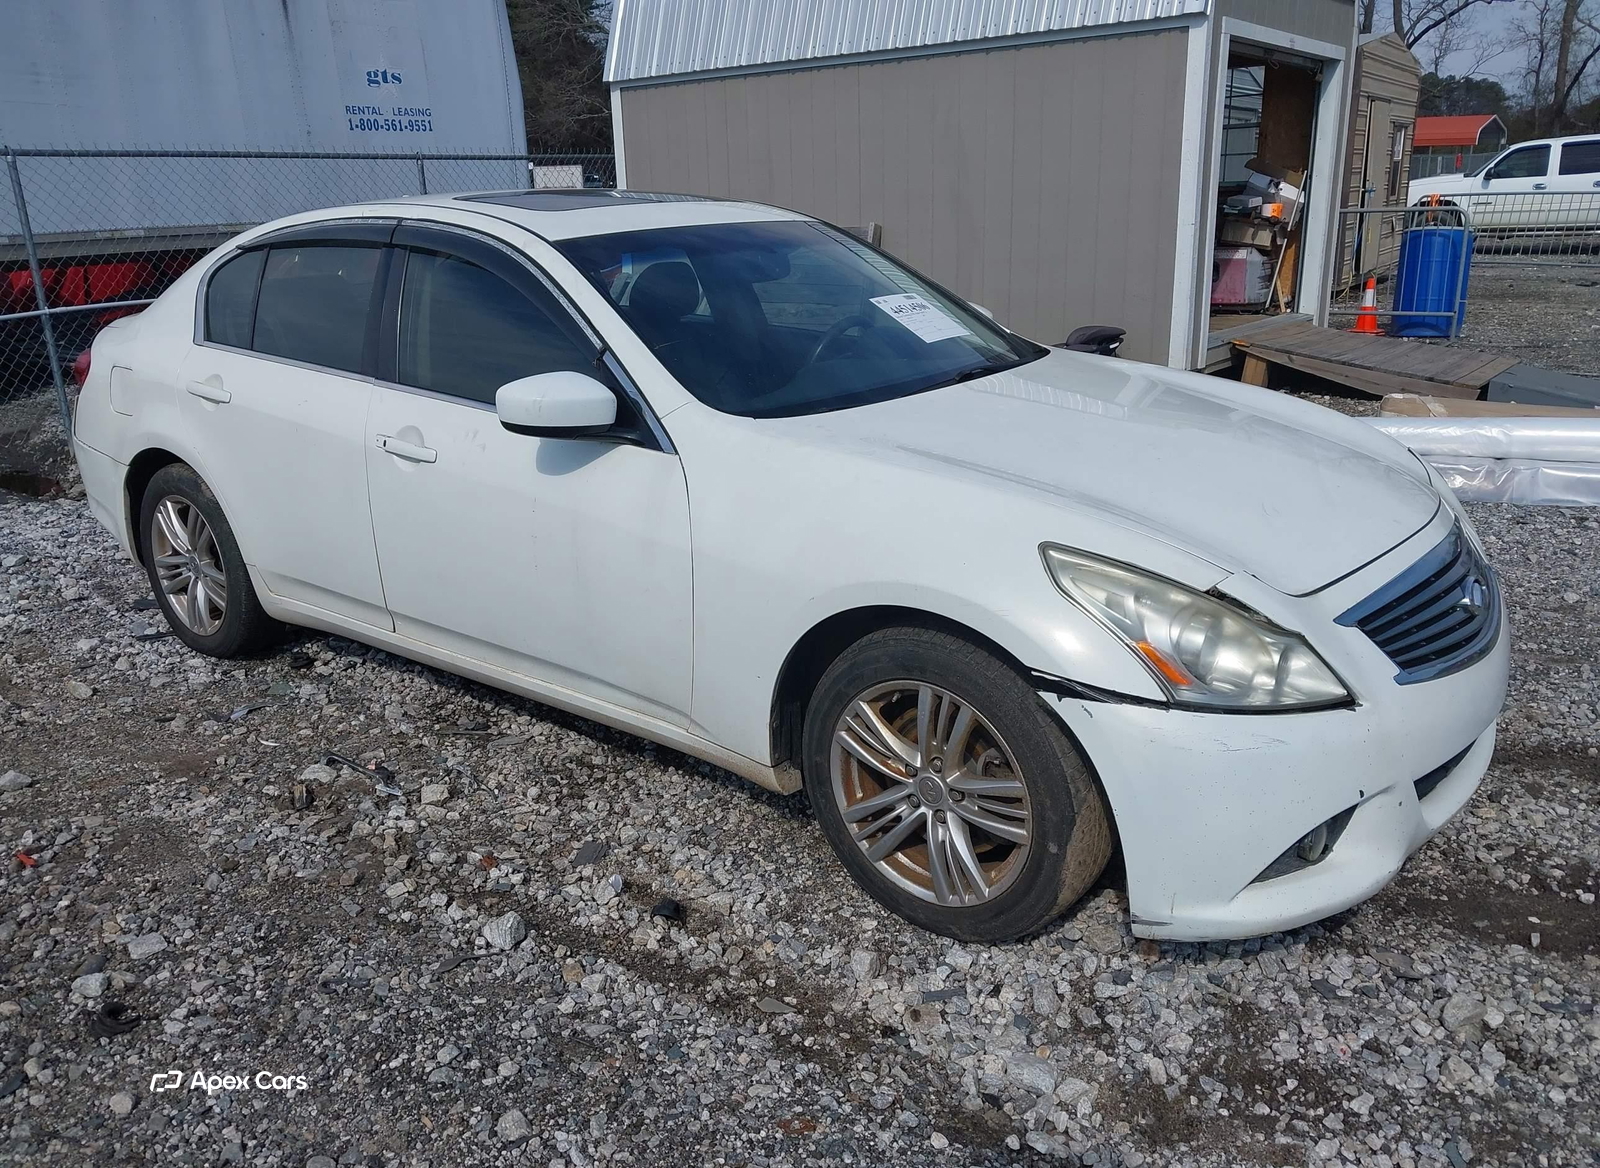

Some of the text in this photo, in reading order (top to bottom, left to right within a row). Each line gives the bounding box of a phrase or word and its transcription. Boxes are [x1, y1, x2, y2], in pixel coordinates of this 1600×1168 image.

[366, 68, 402, 87] gts
[345, 105, 432, 117] RENTAL LEASING
[348, 117, 433, 132] 1-800-561-9551
